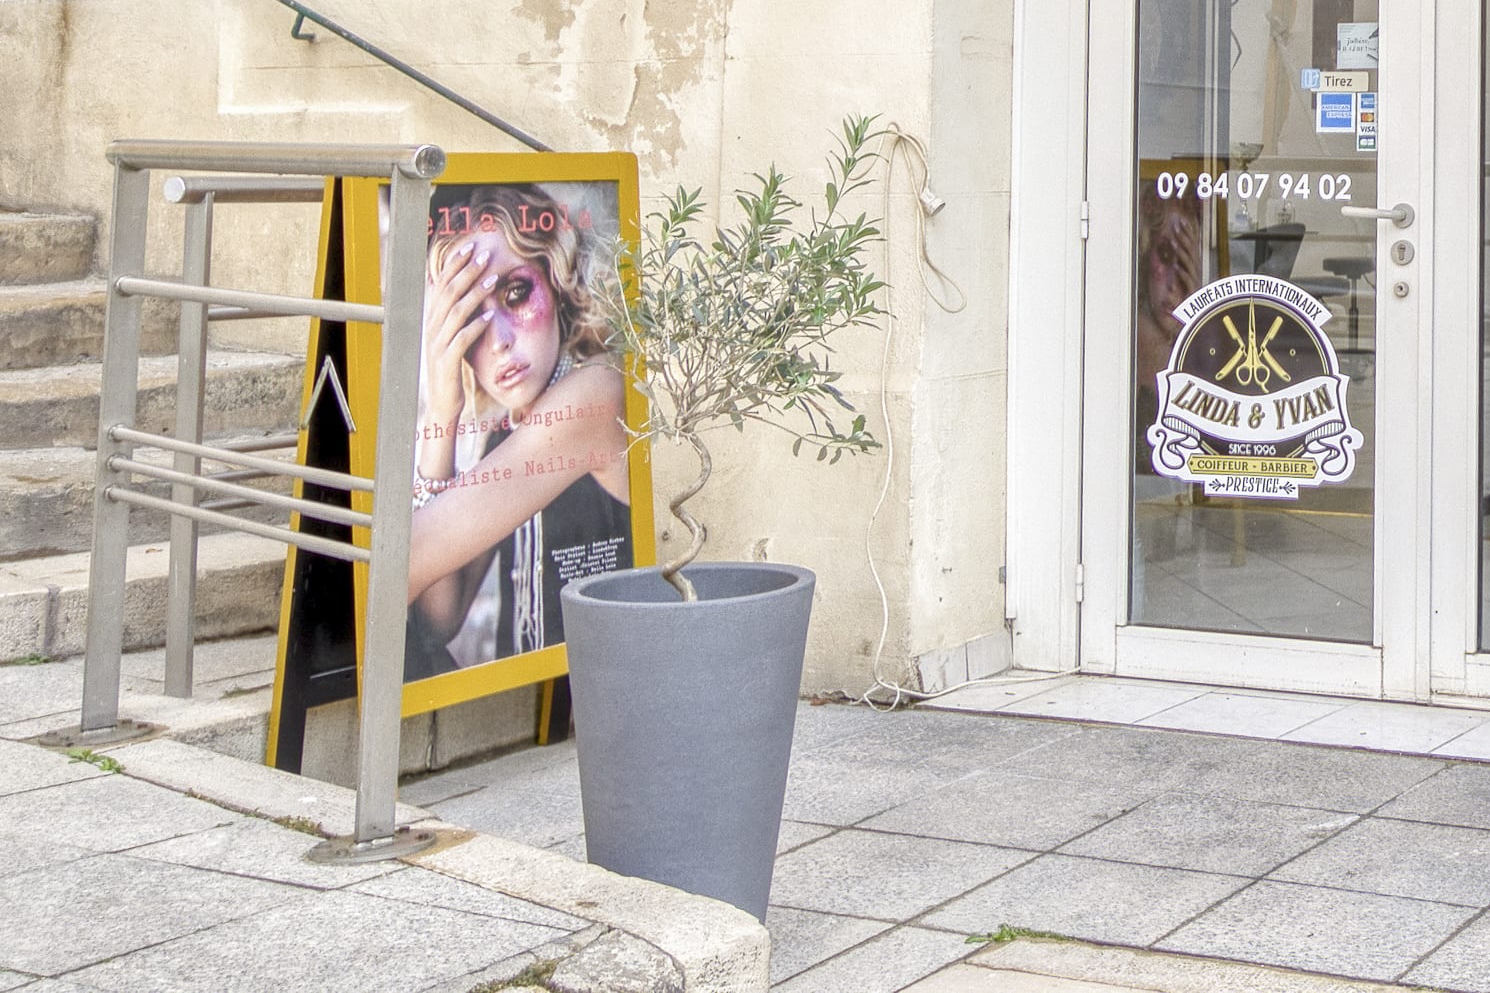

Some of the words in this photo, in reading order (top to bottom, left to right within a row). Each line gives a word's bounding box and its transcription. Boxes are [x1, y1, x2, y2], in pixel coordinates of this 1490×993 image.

[1325, 76, 1352, 86] Tirez
[1157, 172, 1188, 199] 09
[1197, 172, 1228, 199] 84
[1237, 173, 1269, 199] 07
[1279, 173, 1310, 200] 94
[1319, 174, 1352, 200] 02
[519, 205, 592, 233] Lola
[1183, 281, 1233, 319] LAURÉATS
[1235, 278, 1322, 321] INTERNATIONAUX
[1171, 380, 1241, 428] LINDA
[1248, 403, 1265, 429] &
[1273, 384, 1335, 430] YVAN
[1229, 443, 1252, 454] SINCE
[1254, 444, 1276, 455] 1996
[1197, 460, 1249, 470] COIFFEUR
[1261, 462, 1307, 473] BARBIER
[1226, 476, 1279, 493] PRESTIGE
